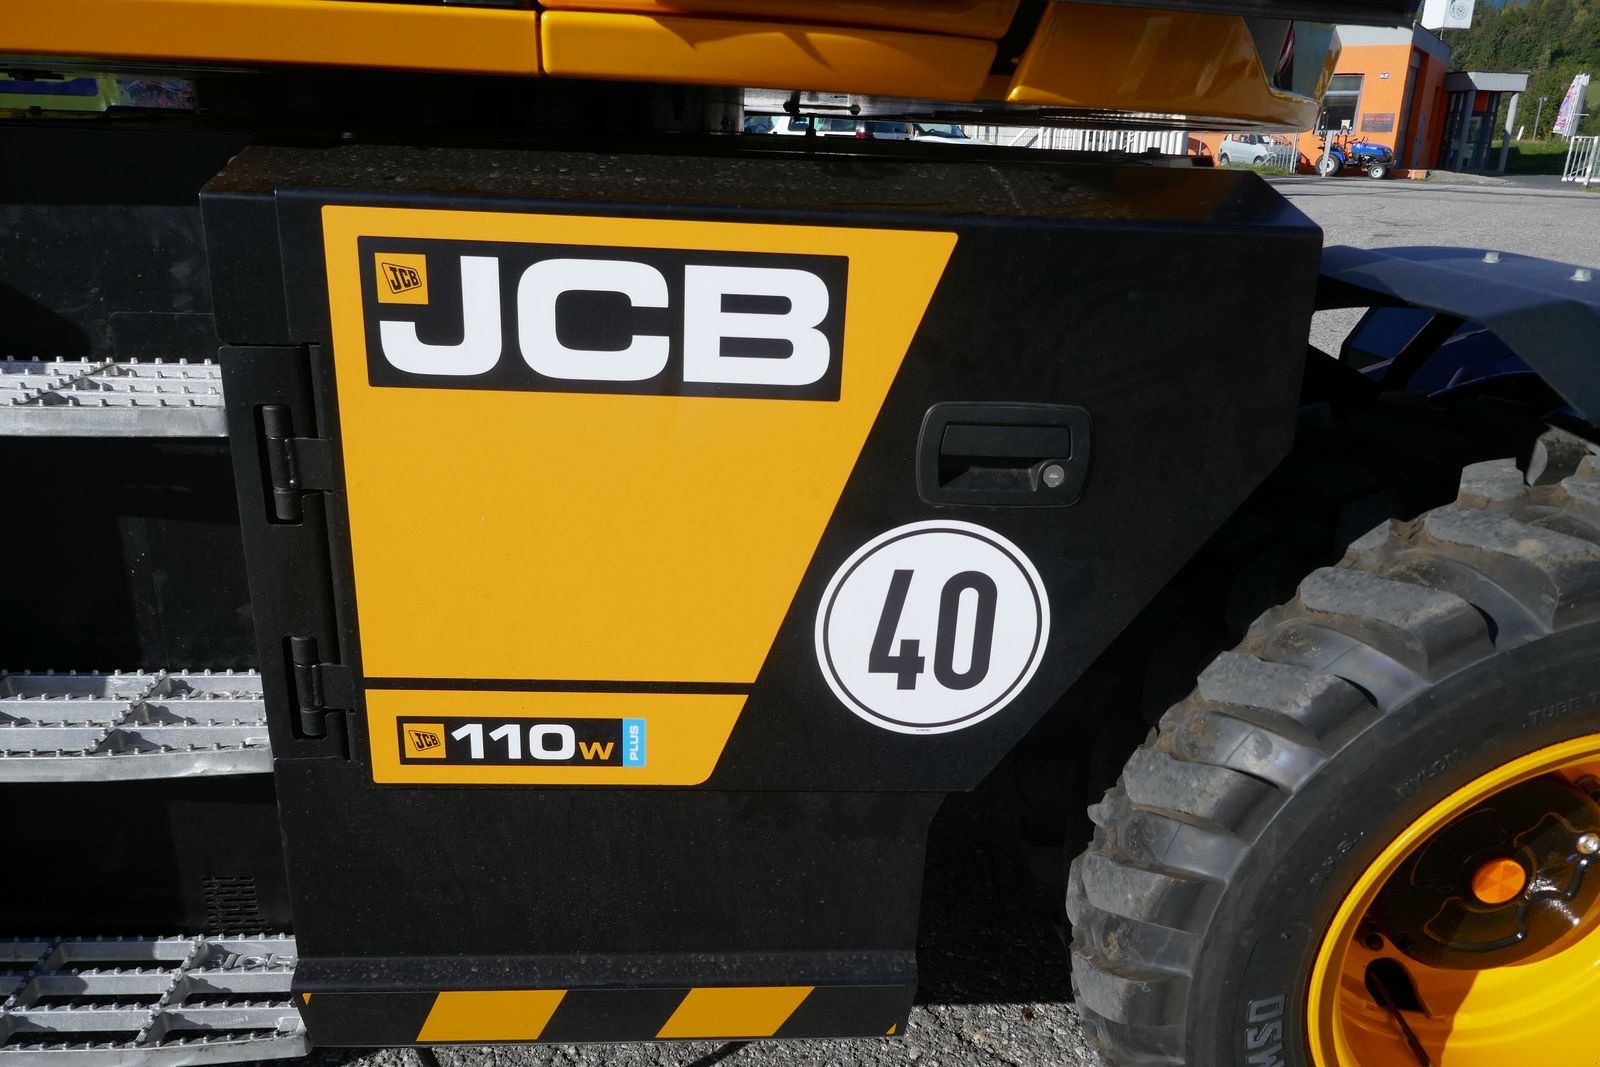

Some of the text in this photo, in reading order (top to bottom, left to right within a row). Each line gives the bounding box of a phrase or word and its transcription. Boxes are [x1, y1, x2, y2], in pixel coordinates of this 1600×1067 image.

[388, 266, 419, 291] JCB
[379, 255, 831, 386] JCB
[868, 569, 998, 691] 40
[414, 732, 439, 749] JCB
[629, 725, 639, 761] PLUS
